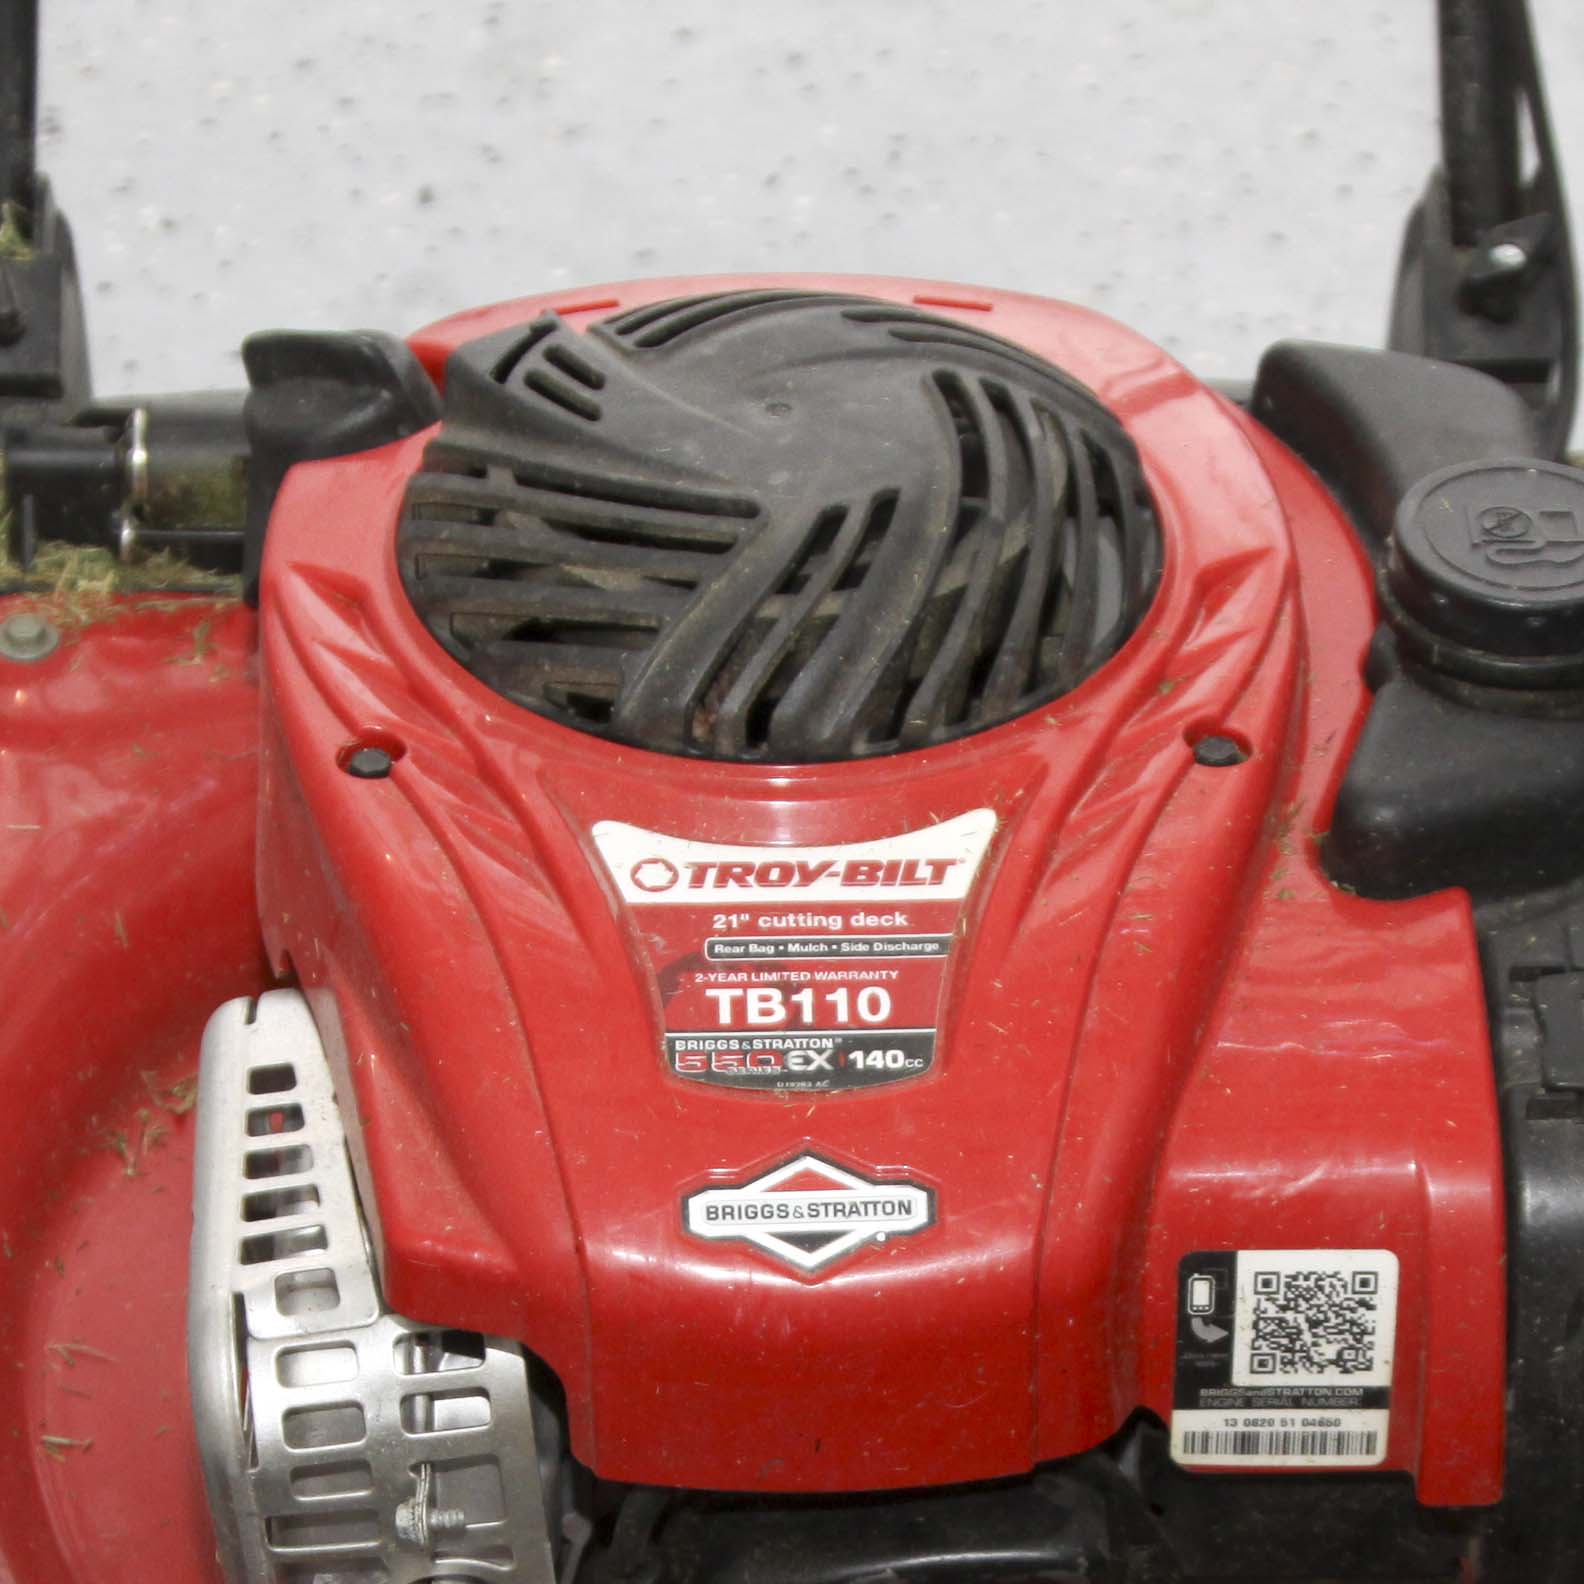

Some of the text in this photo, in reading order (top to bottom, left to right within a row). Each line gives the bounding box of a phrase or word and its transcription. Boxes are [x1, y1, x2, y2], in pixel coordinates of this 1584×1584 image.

[686, 858, 957, 888] TROY-BILT
[713, 912, 909, 930] 21" cutting deck
[714, 940, 940, 955] Rear Bag Mulch Side Discharge
[695, 970, 899, 983] 2-YEAR LIMITED WARRANTY
[705, 986, 891, 1025] TB110
[848, 1050, 924, 1069] 140cc
